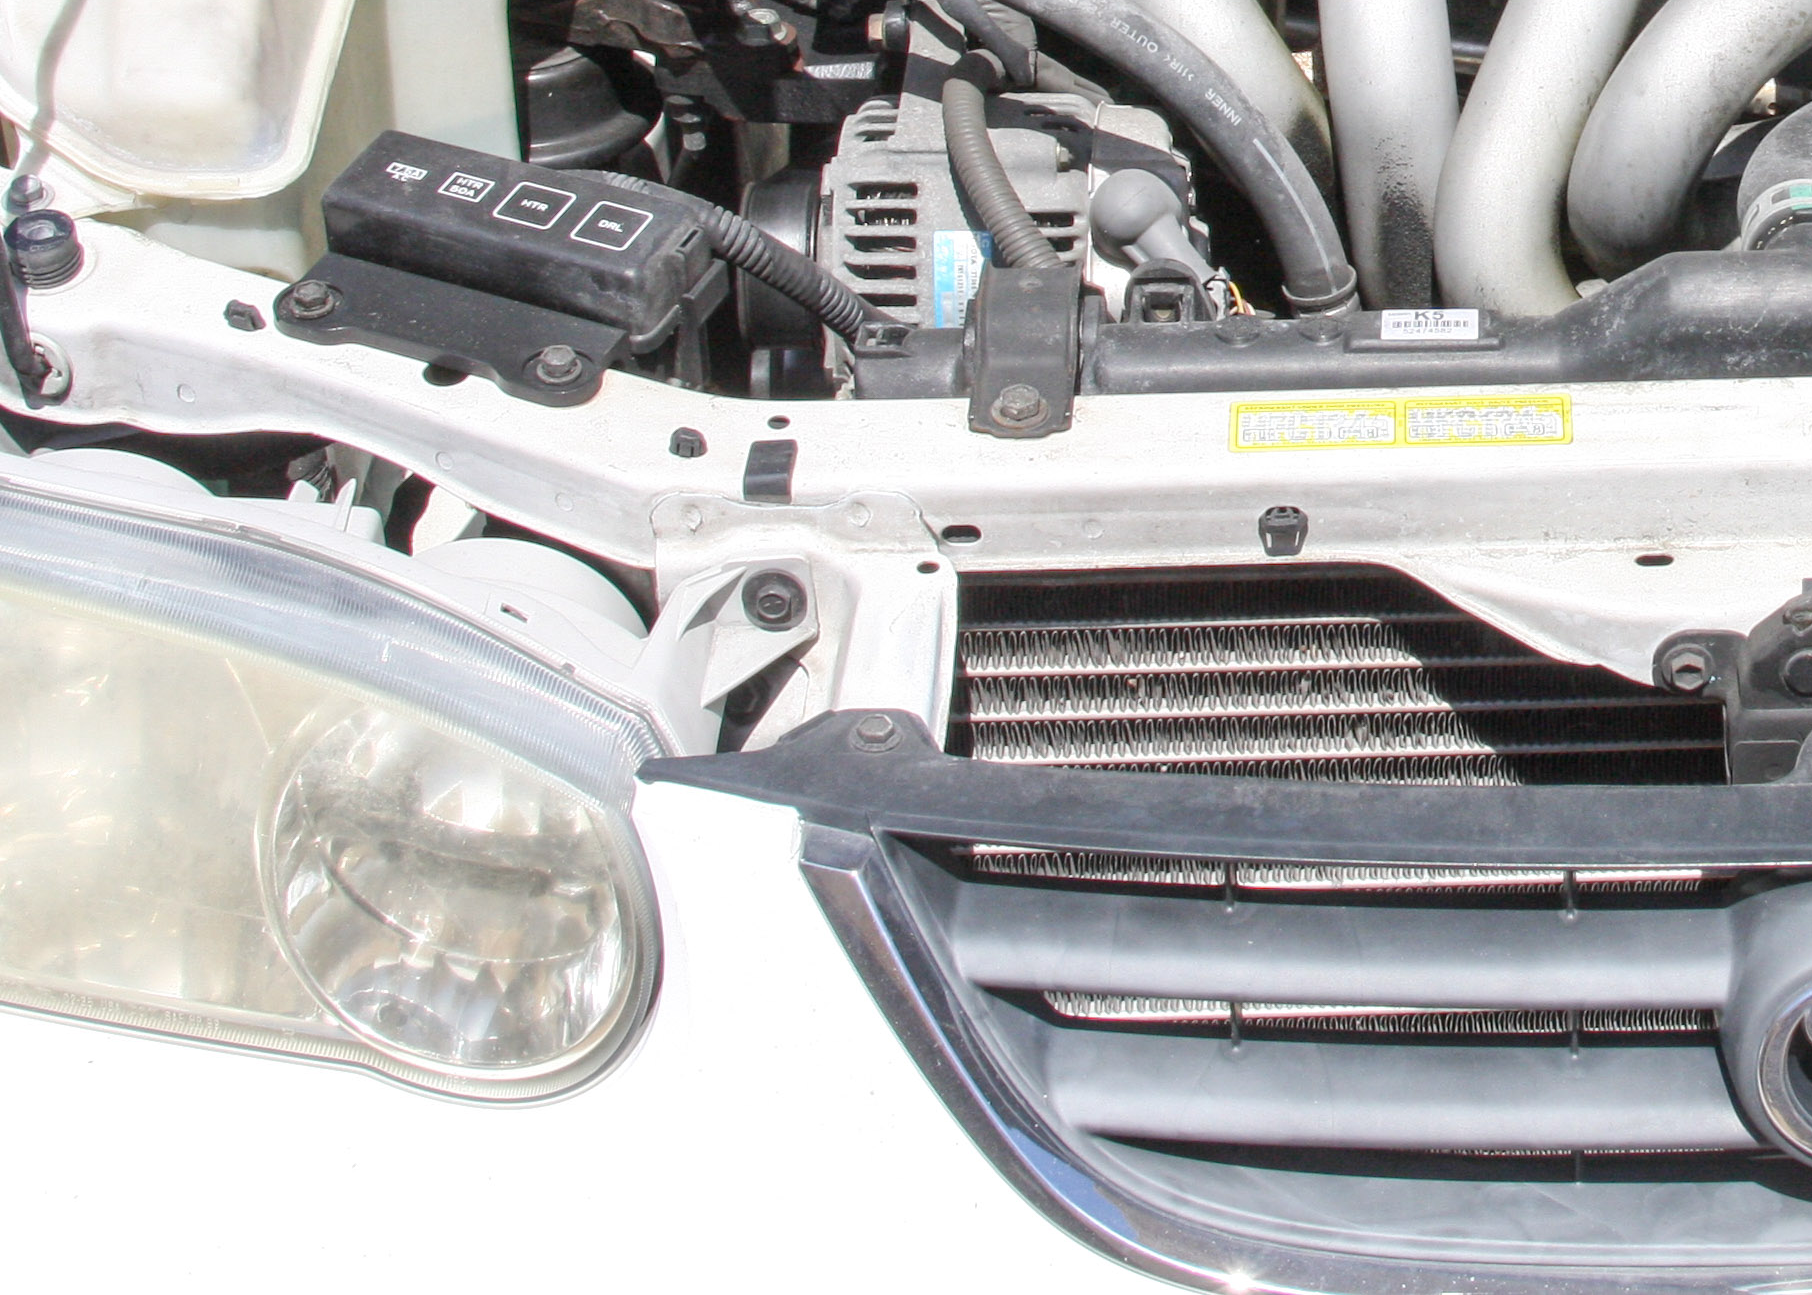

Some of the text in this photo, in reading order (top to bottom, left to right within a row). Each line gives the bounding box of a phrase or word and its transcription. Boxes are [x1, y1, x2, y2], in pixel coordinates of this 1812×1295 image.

[1110, 17, 1159, 54] OUTER
[1203, 87, 1242, 126] INNER
[456, 177, 485, 190] HTR
[521, 198, 549, 212] HTR
[598, 218, 625, 233] DRL
[1414, 310, 1445, 321] K5
